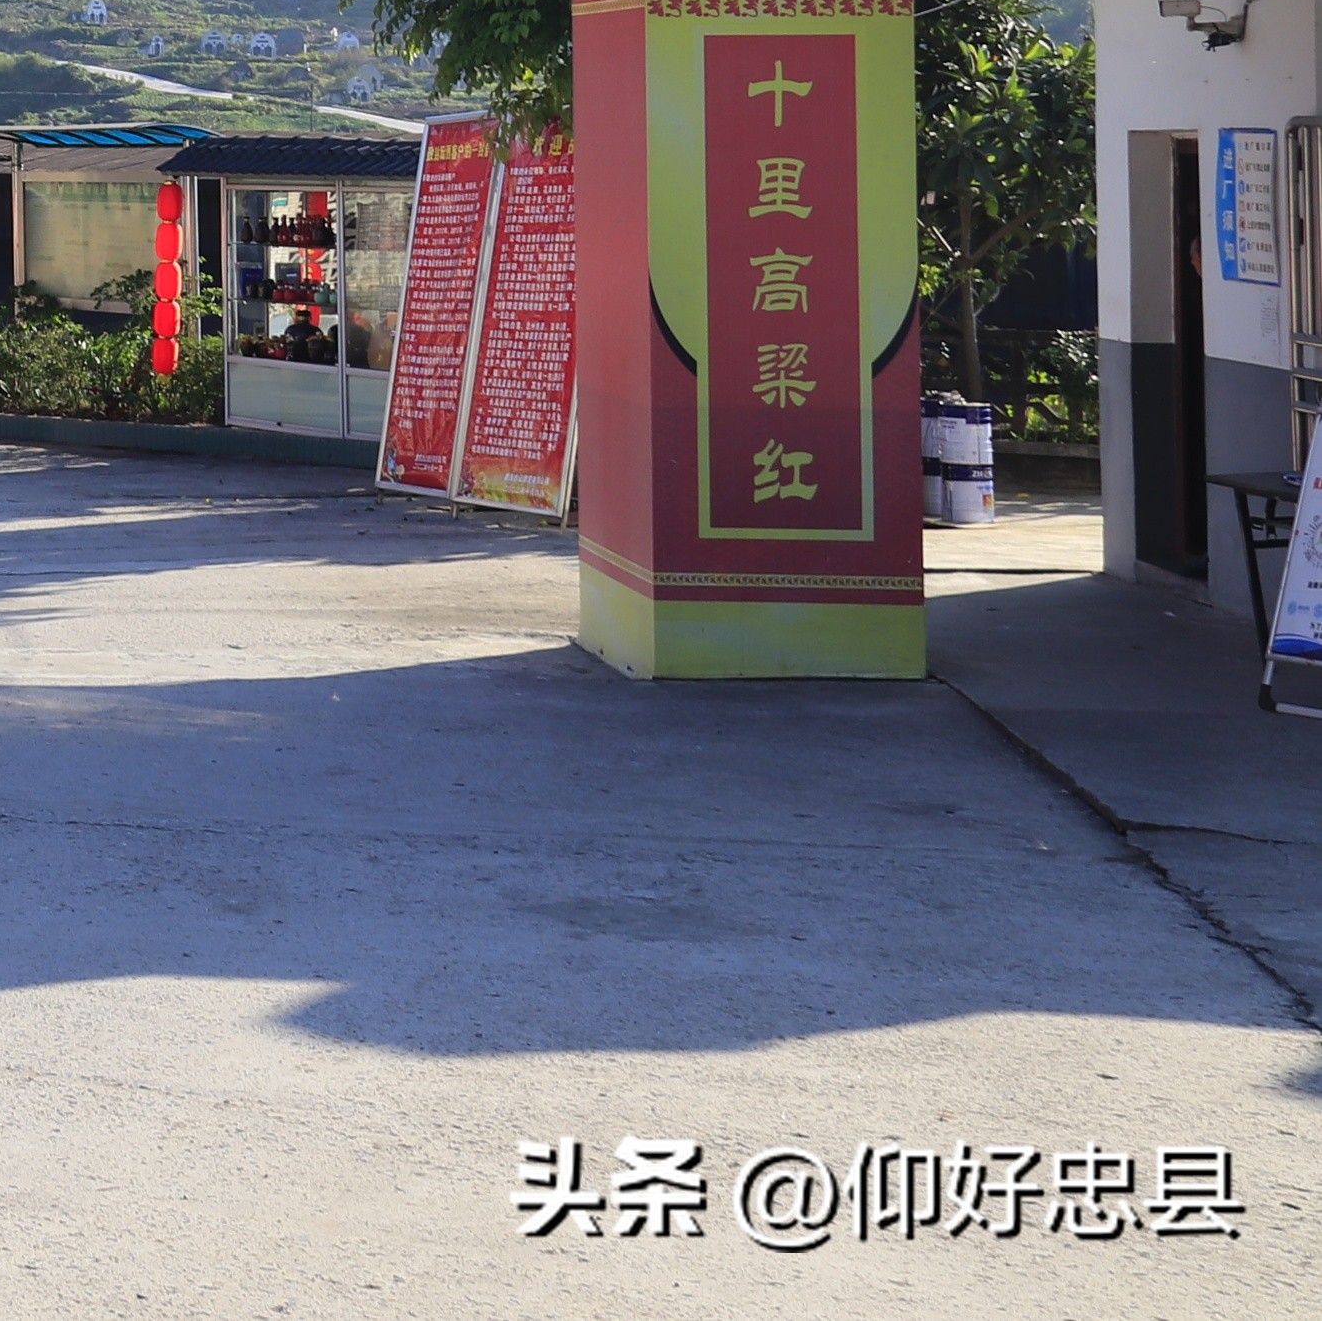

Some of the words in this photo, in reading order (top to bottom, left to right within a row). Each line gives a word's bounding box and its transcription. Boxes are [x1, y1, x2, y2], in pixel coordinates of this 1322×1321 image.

[748, 59, 818, 504] 十里高粱红
